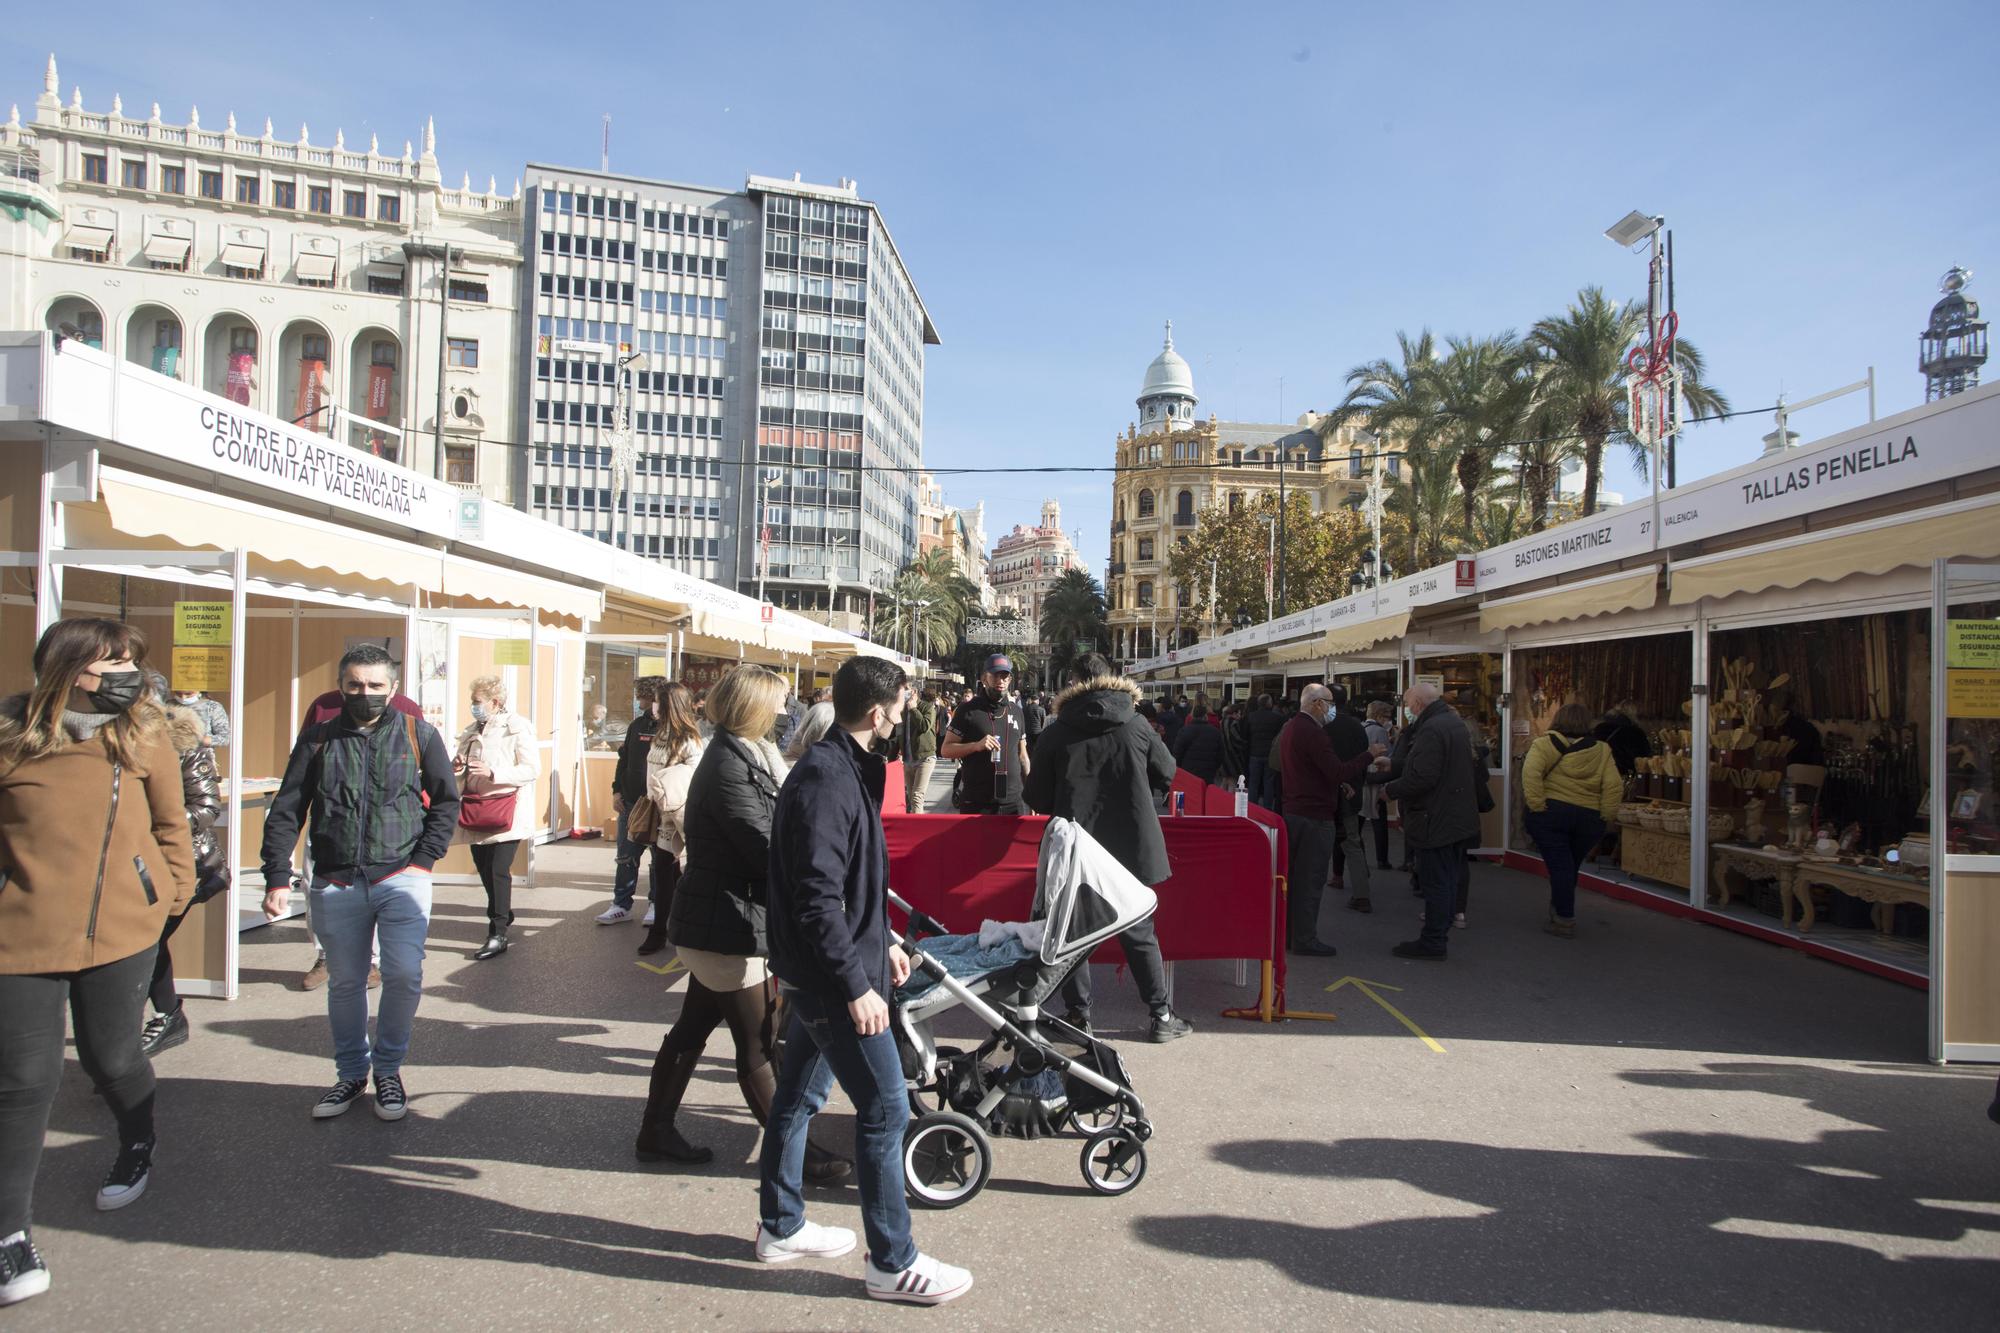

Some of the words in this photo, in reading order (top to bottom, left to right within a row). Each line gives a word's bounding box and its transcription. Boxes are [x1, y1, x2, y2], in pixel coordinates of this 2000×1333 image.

[201, 406, 281, 453] CENTRE
[392, 475, 408, 496] DE
[412, 482, 427, 503] LA
[1742, 467, 1810, 505] TALLAS
[1816, 436, 1918, 484] PENELLA
[212, 435, 319, 487] COMUNITAT
[324, 471, 411, 516] VALENCIANA
[1640, 520, 1651, 534] 27
[1664, 509, 1699, 526] VALENCIA
[1515, 544, 1559, 568] BASTONES
[1561, 527, 1612, 555] MARTINEZ
[1409, 583, 1420, 597] BOX
[1423, 580, 1438, 593] TANA
